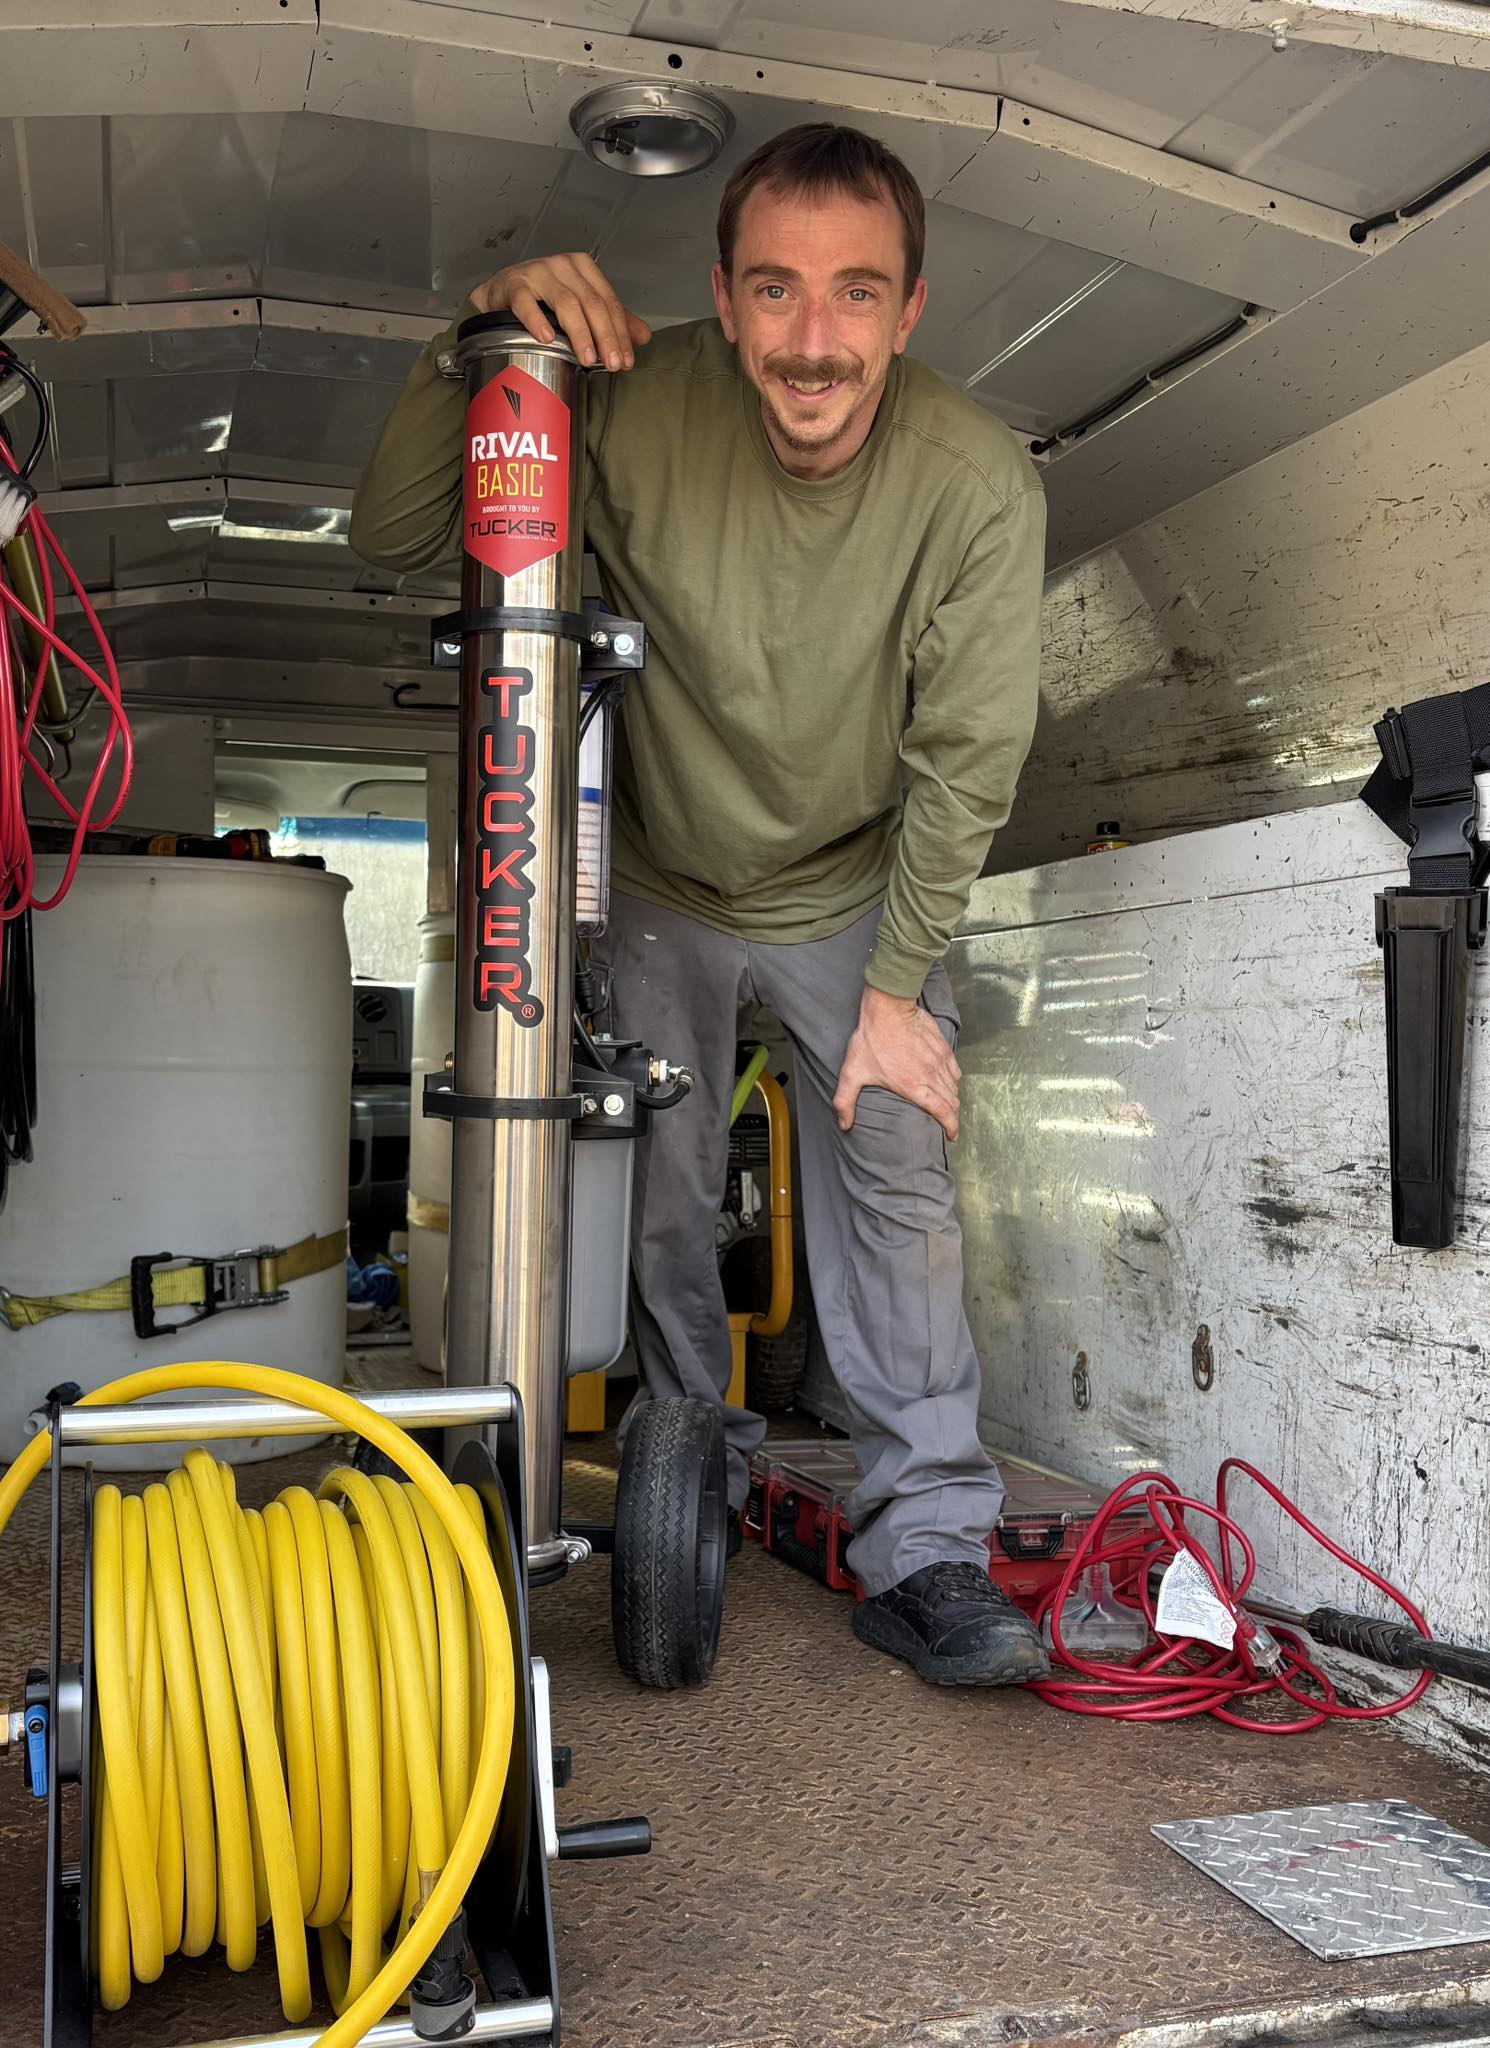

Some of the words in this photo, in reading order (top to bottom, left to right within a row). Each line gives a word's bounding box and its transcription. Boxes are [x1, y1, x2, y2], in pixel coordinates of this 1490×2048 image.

[471, 431, 558, 463] RIVAL
[477, 463, 544, 499] BASIC
[482, 504, 507, 514] BROUGHT
[508, 504, 517, 513] TO
[517, 505, 531, 513] YOU
[531, 505, 540, 513] BY
